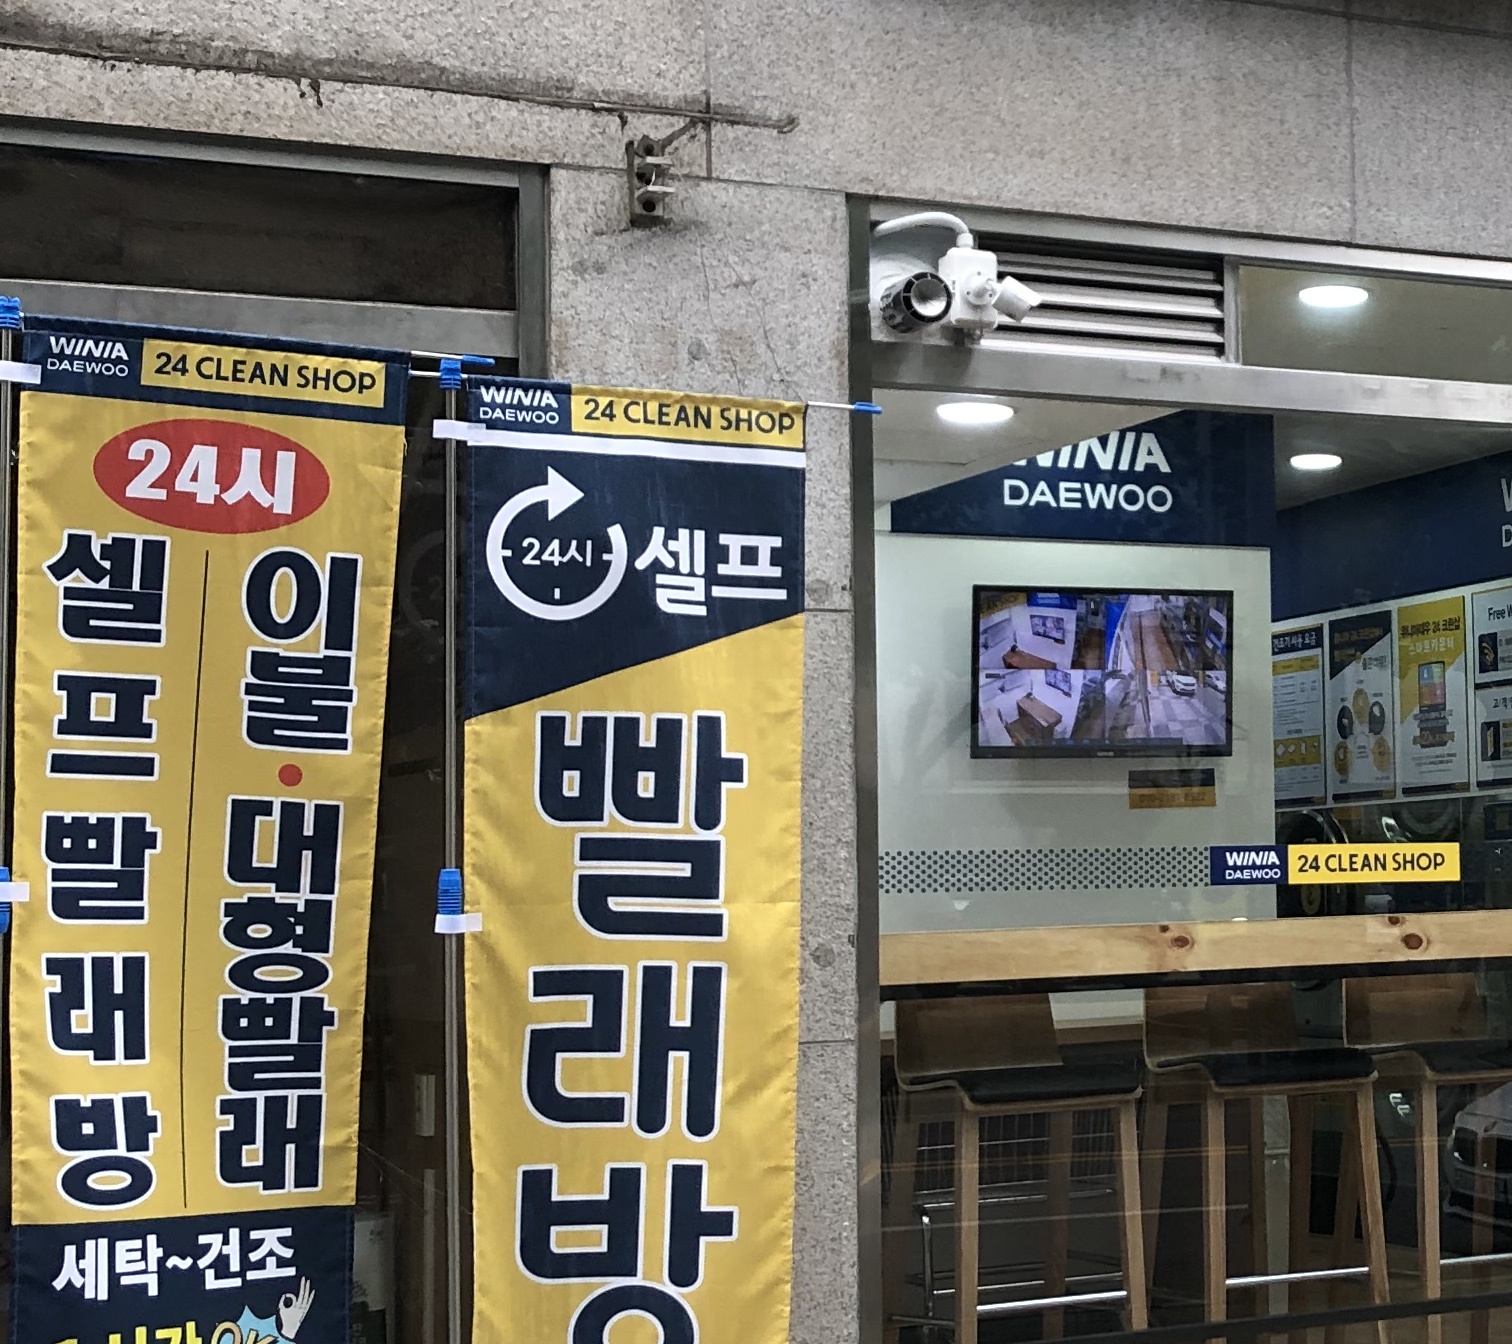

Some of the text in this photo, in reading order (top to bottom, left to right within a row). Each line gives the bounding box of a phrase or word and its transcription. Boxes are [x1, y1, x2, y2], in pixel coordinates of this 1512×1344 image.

[49, 336, 129, 361] WINIA
[46, 358, 129, 377] DAEWOO
[155, 351, 377, 394] 24 CLEAN SHOP
[480, 385, 559, 409] WINIA
[479, 406, 560, 425] DAEWOO
[583, 398, 795, 435] 24 CLEAN SHOP
[126, 439, 296, 515] 24시
[1003, 479, 1173, 513] DAEWOO
[521, 538, 593, 567] 24시
[634, 526, 788, 616] 셀프
[1488, 606, 1506, 621] Free
[1225, 851, 1280, 868] WINIA
[1297, 852, 1445, 874] 24 CLEAN SHOP
[1225, 868, 1281, 880] DAEWOO
